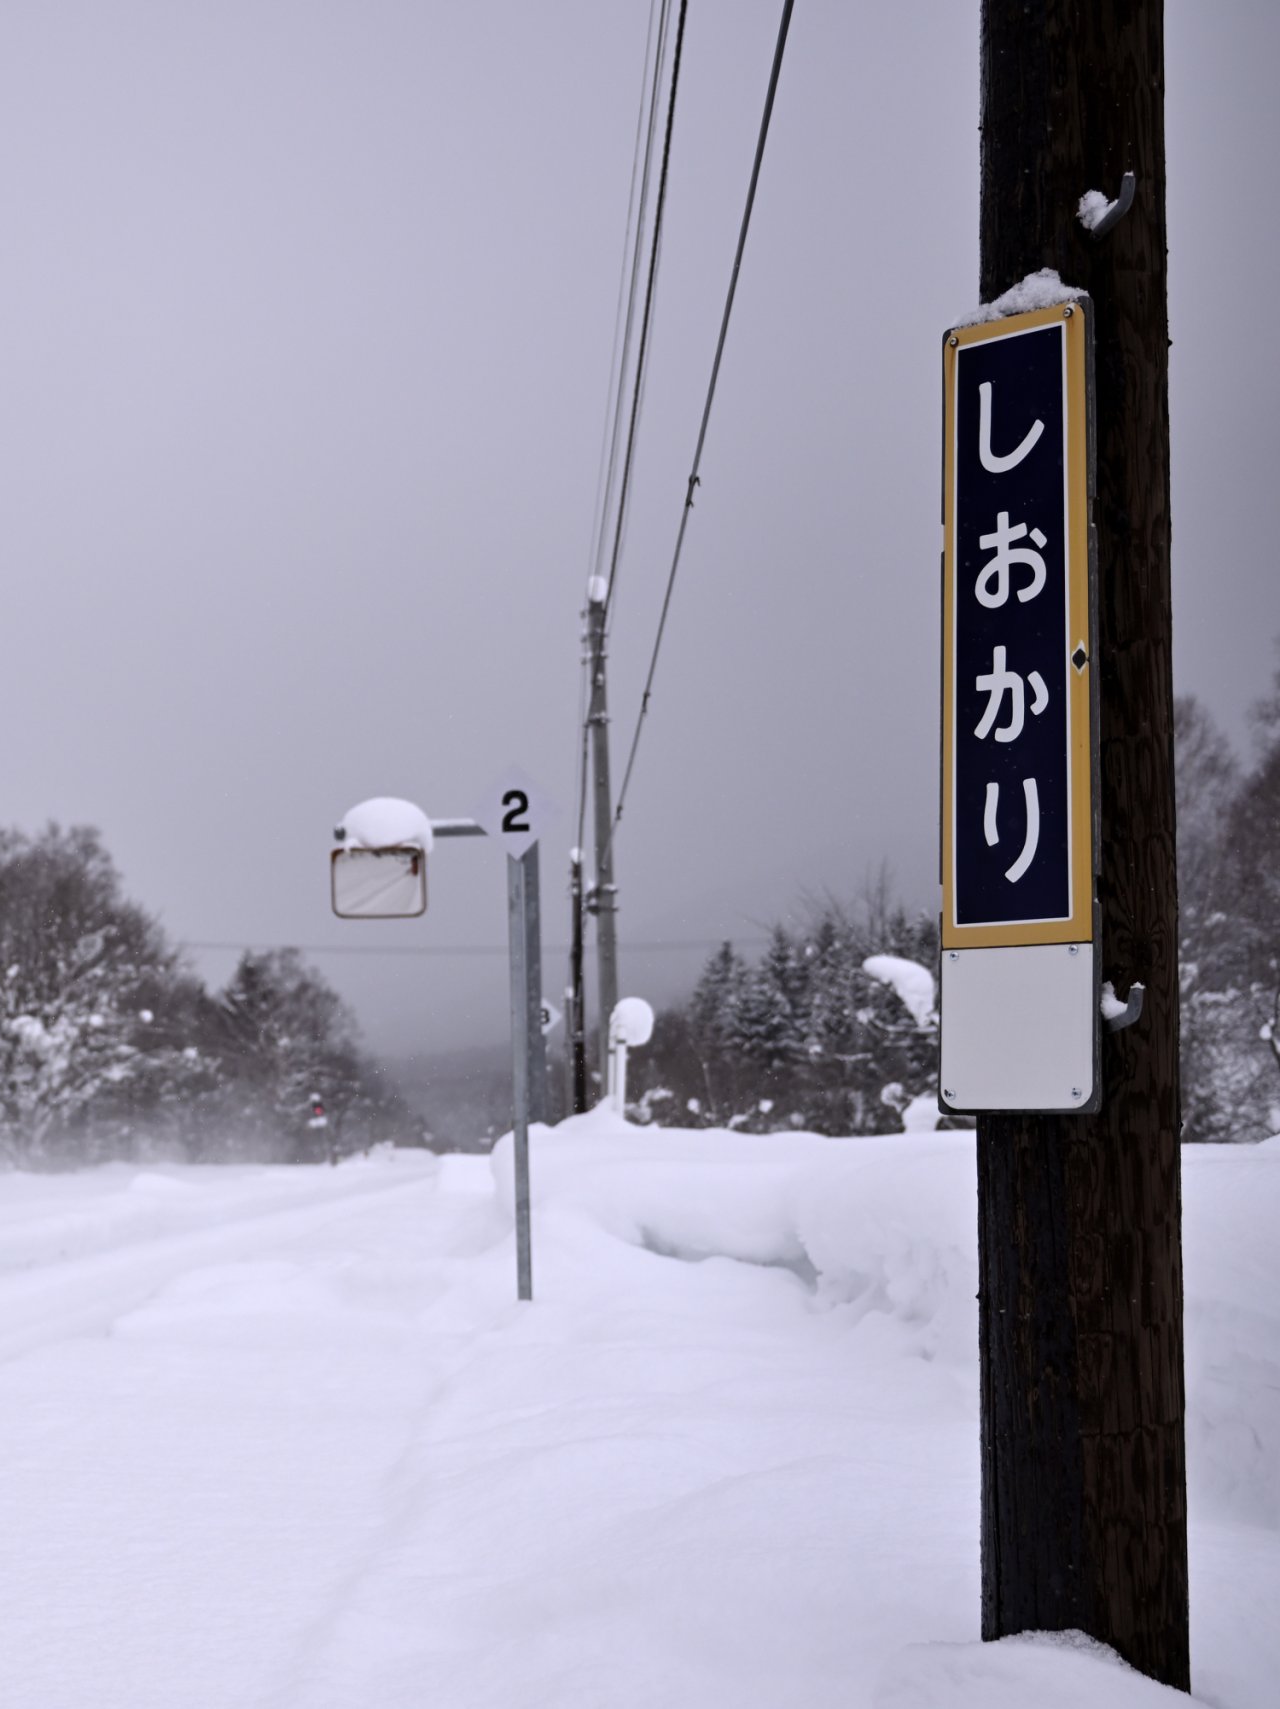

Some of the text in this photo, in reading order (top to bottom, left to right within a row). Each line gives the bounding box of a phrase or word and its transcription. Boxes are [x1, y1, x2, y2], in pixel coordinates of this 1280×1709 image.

[975, 381, 1048, 882] しおかり
[502, 789, 529, 832] 2
